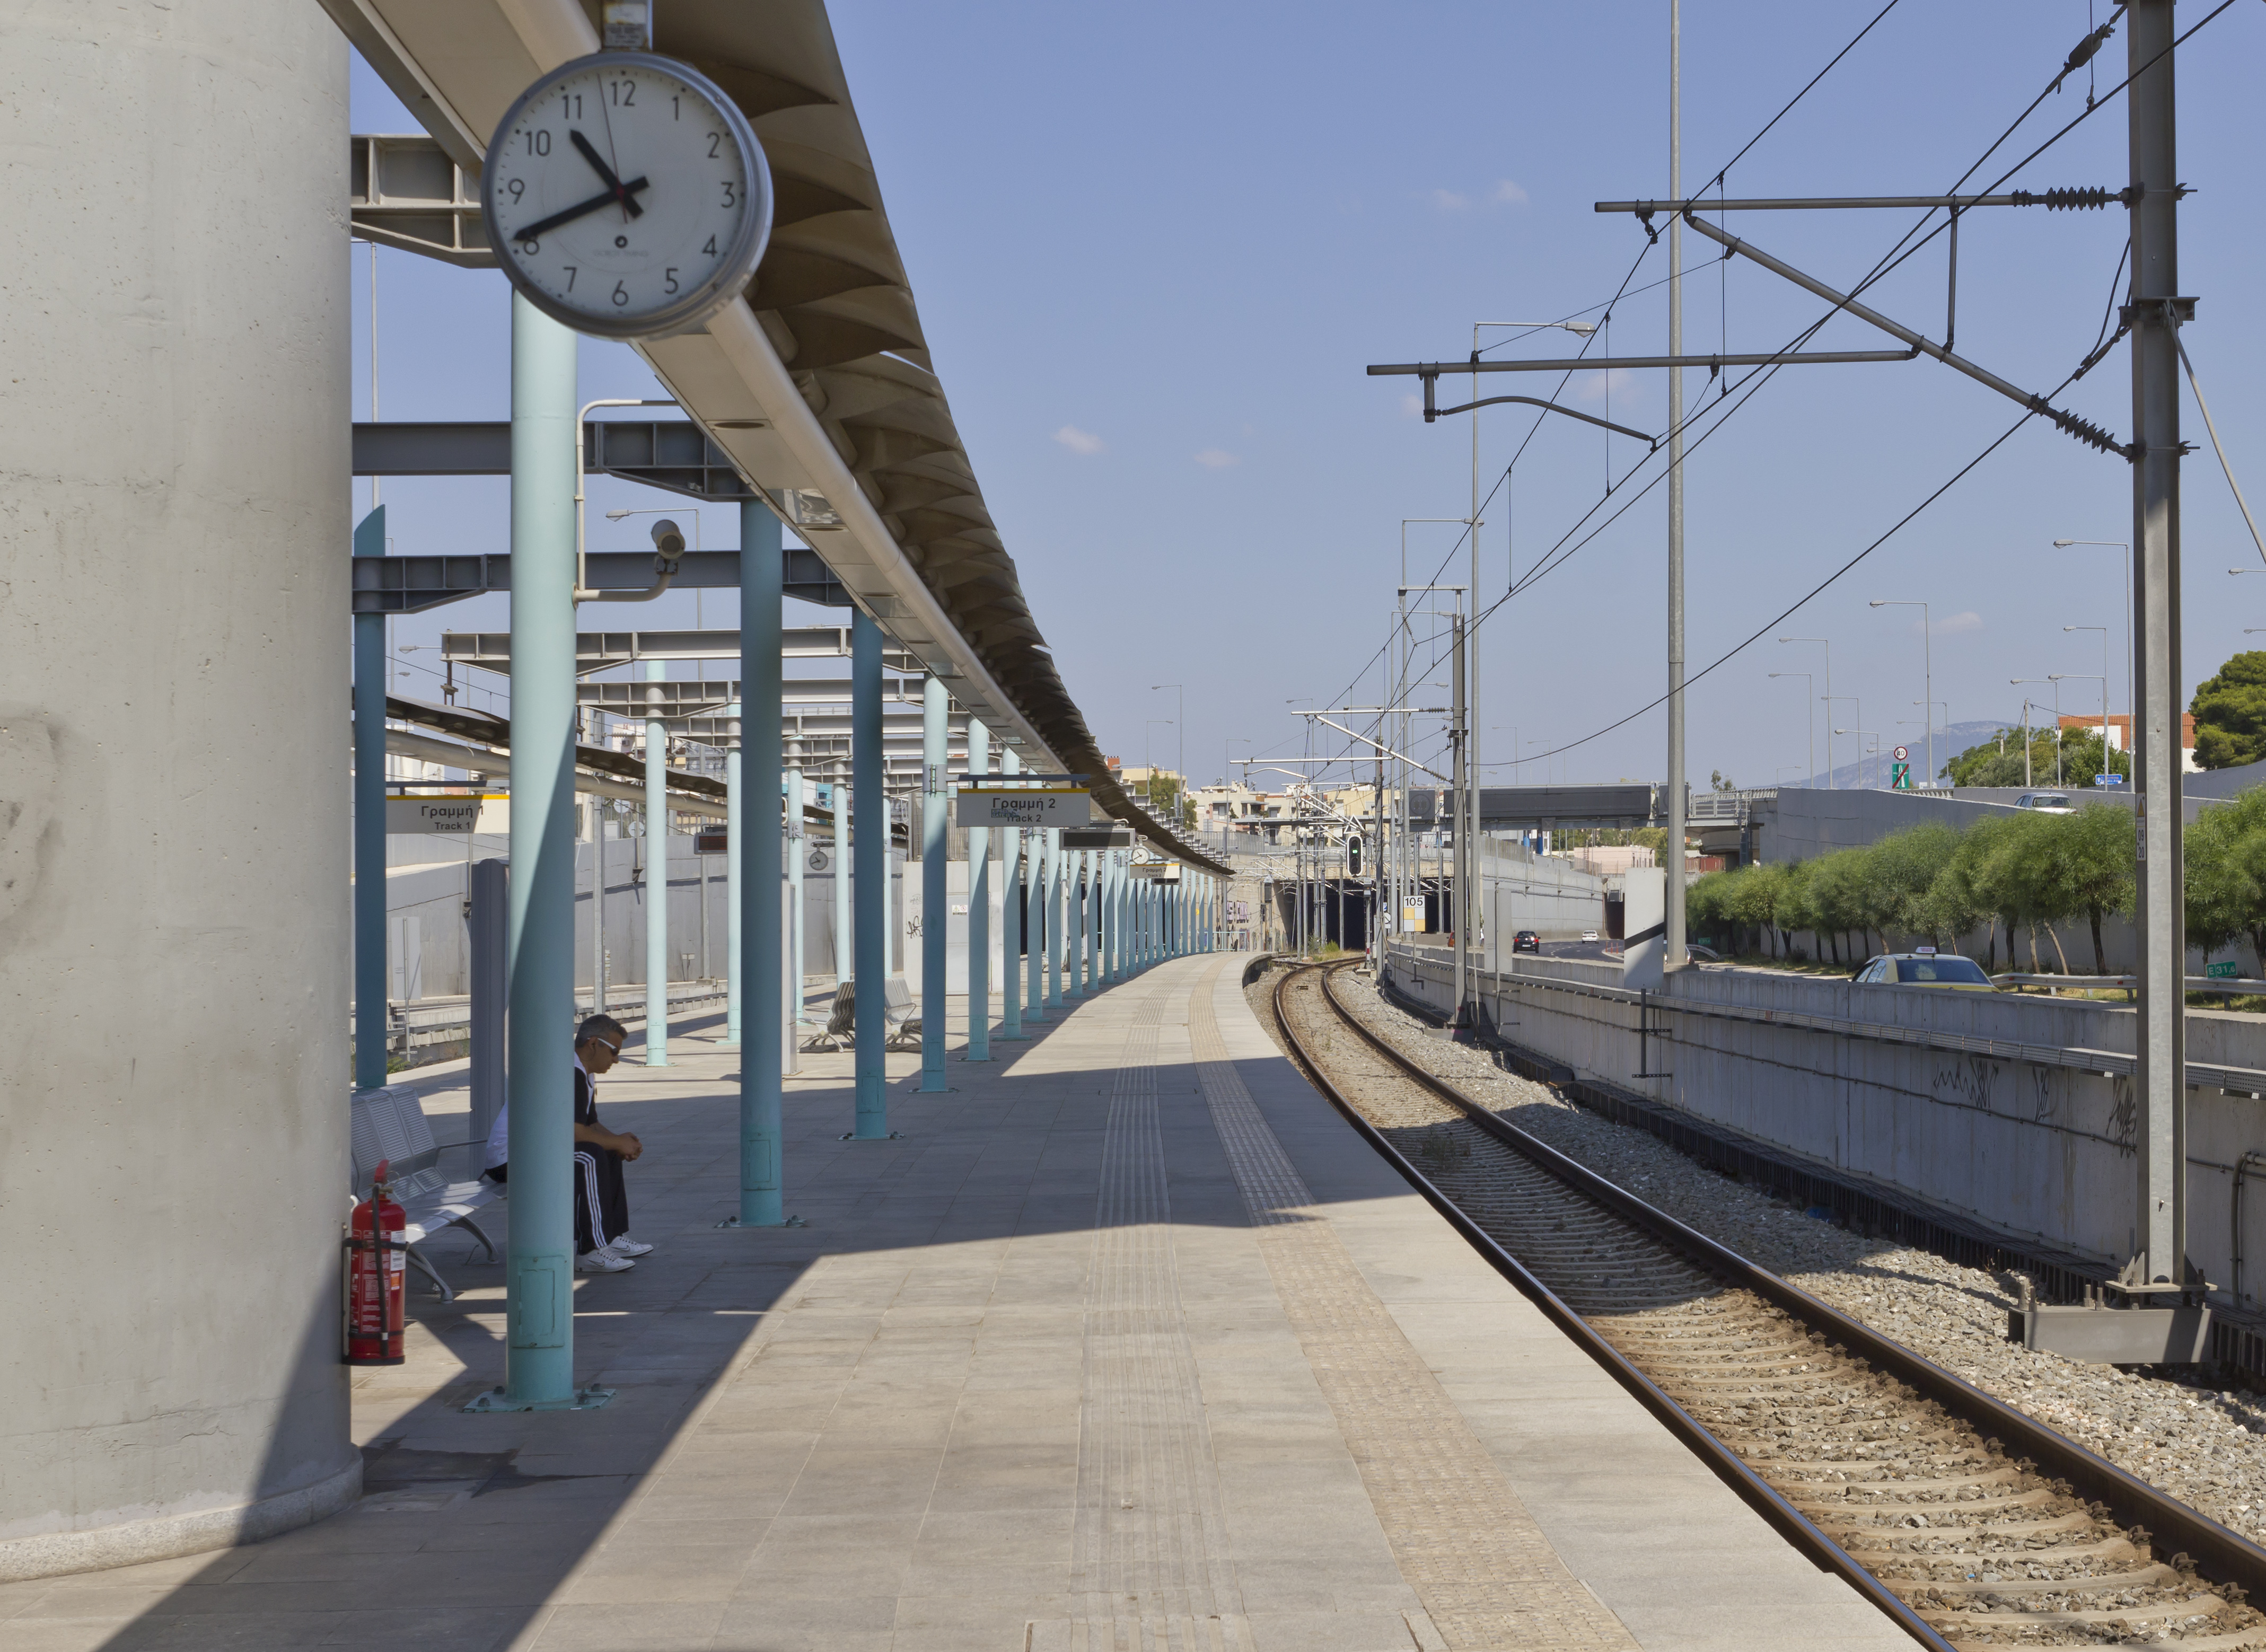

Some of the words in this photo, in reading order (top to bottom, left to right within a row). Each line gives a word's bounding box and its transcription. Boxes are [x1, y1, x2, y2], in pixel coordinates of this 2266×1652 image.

[610, 80, 636, 107] 12
[561, 94, 582, 120] 11
[672, 95, 679, 121] 1
[525, 129, 551, 157] 10
[706, 132, 720, 159] 2
[508, 178, 525, 205] 9
[721, 181, 736, 208] 3
[702, 233, 718, 258] 4
[563, 266, 577, 292] 7
[664, 267, 679, 294] 5
[612, 279, 629, 307] 6
[421, 805, 473, 819] Γραμμή
[478, 805, 483, 815] 1
[993, 798, 1043, 811] Γραμμή
[1048, 798, 1056, 809] 2
[2138, 829, 2144, 841] 09
[2138, 846, 2145, 858] 20
[1405, 898, 1423, 906] 105
[2216, 965, 2235, 974] 31,6
